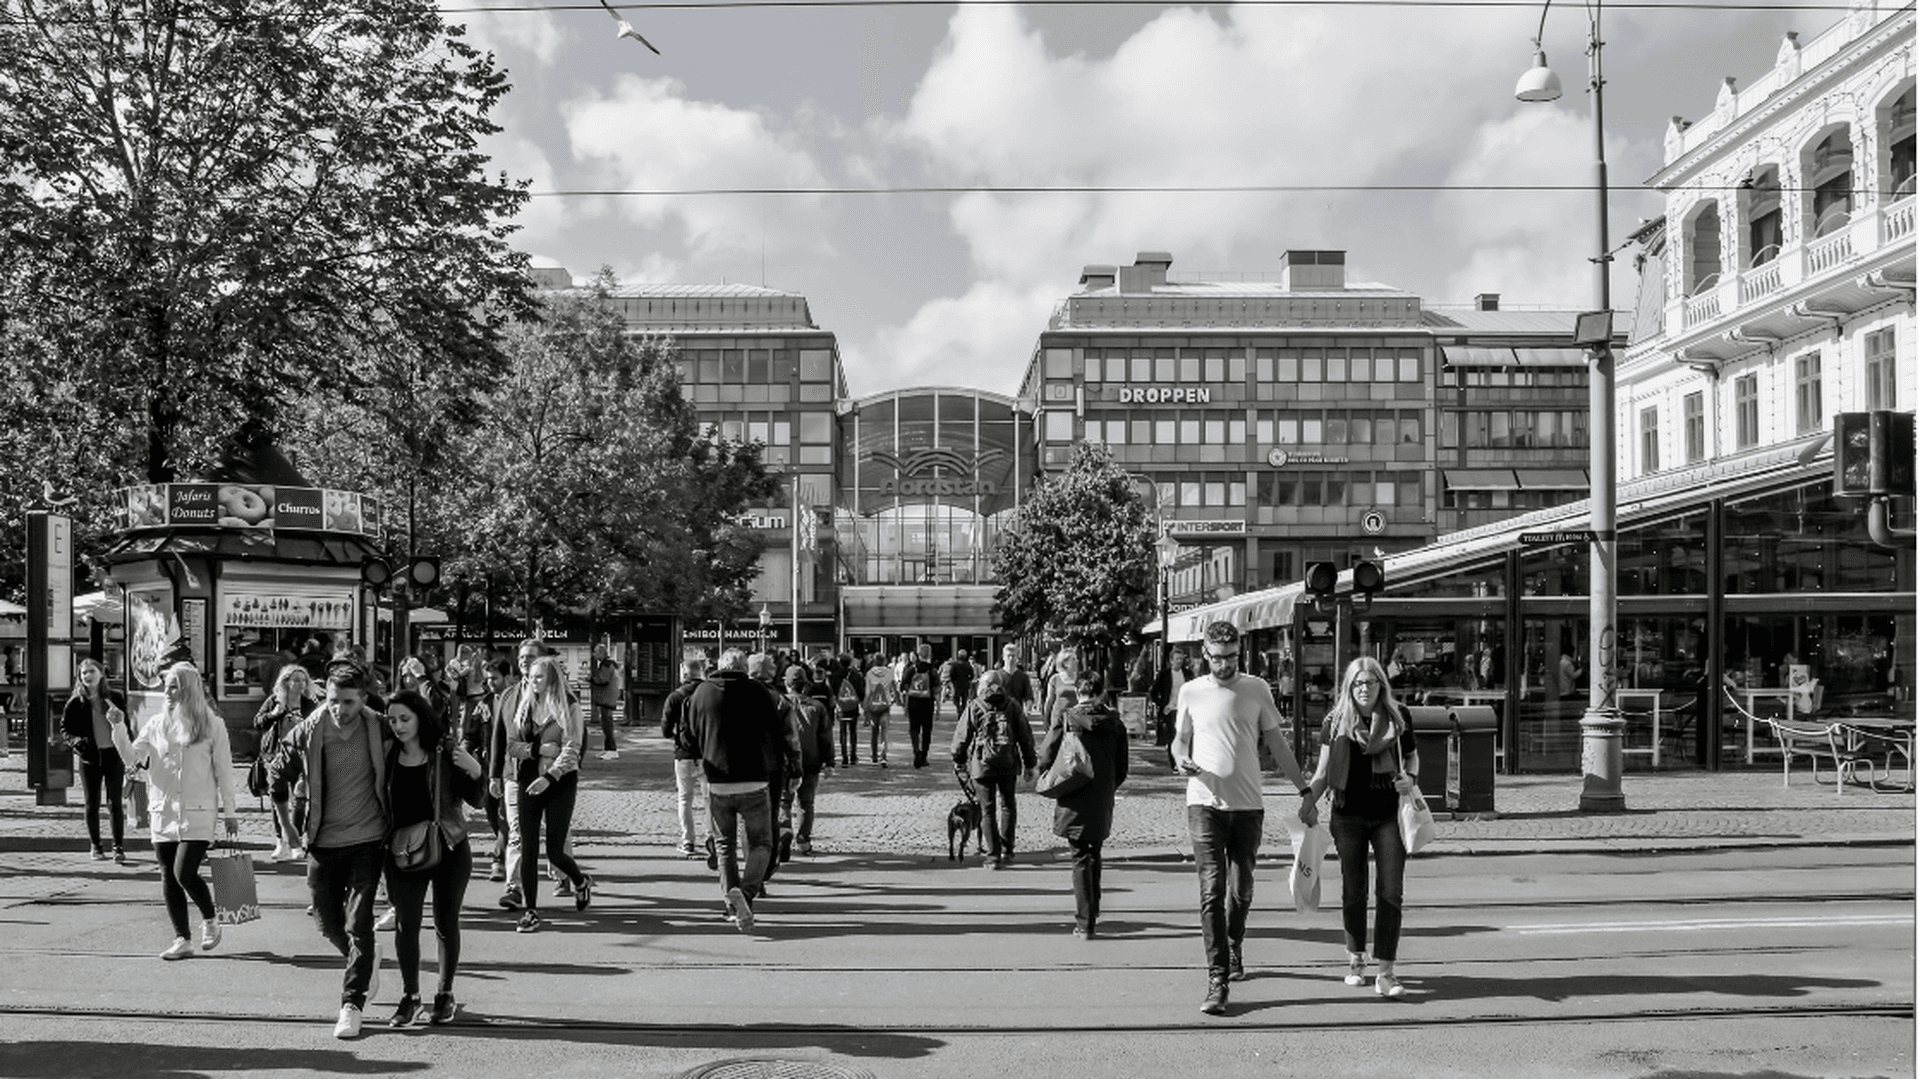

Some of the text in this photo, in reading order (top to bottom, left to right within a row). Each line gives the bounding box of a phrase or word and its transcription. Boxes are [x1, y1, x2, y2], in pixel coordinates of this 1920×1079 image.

[1120, 388, 1210, 403] DROPPEN
[171, 506, 215, 519] Donuts
[278, 502, 320, 515] Churros
[1177, 522, 1244, 532] INTERSPORT
[55, 524, 62, 553] E
